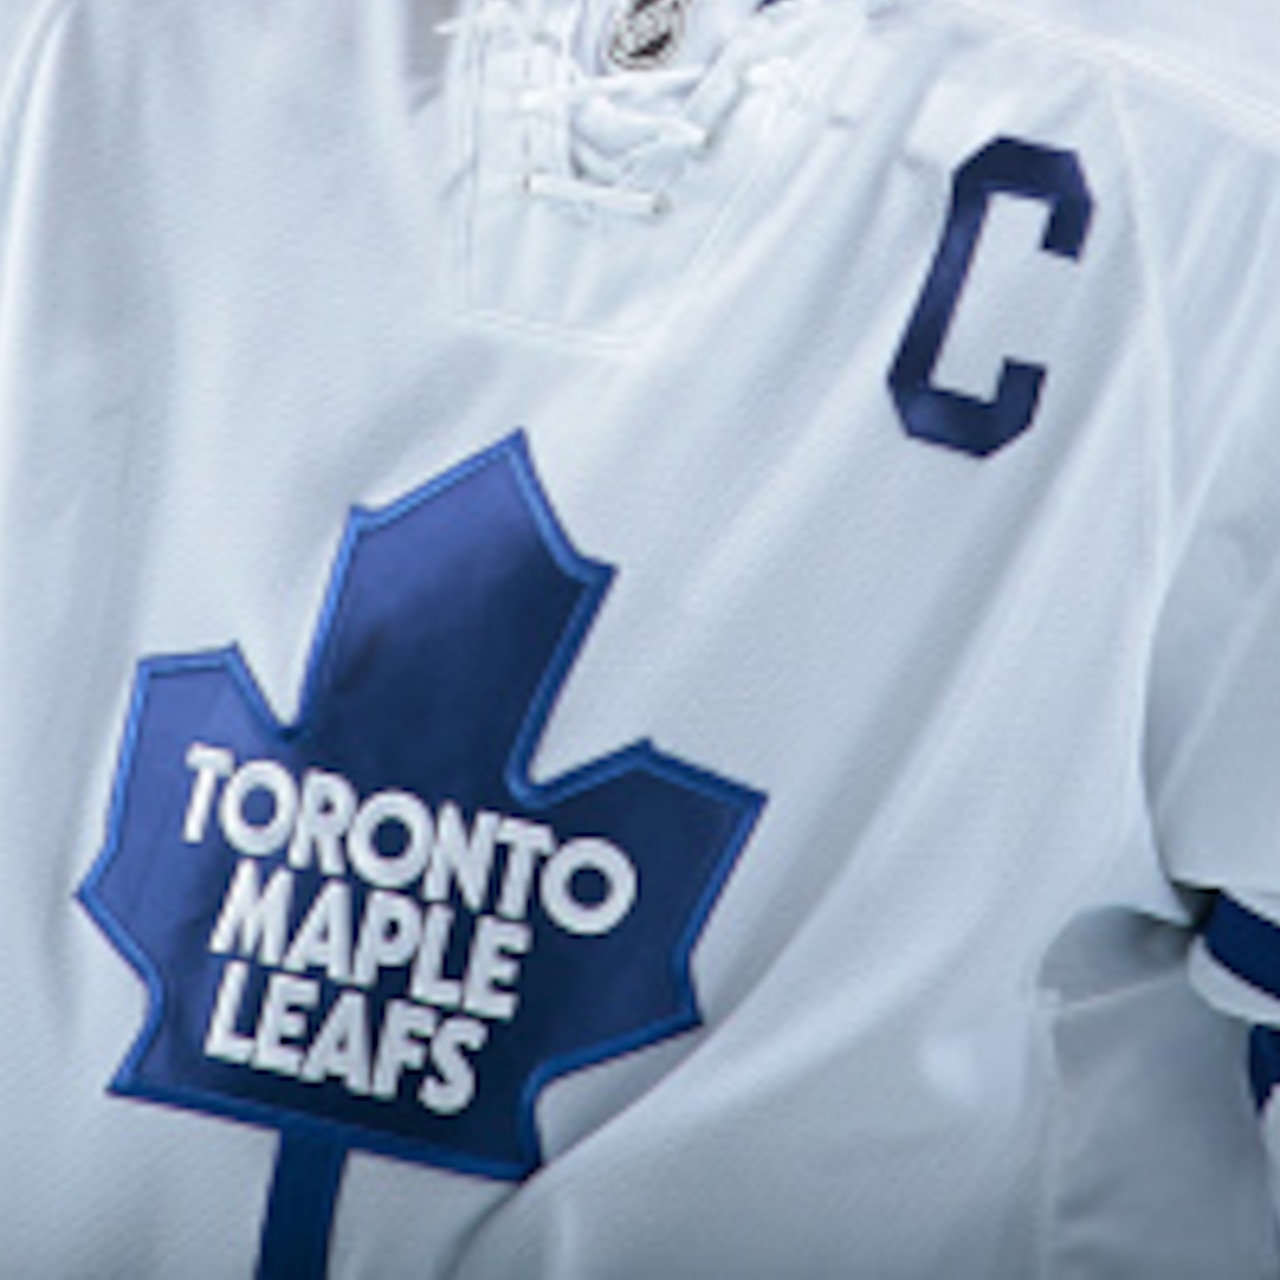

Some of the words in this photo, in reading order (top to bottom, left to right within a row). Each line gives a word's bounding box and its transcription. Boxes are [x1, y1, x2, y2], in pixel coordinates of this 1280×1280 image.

[887, 136, 1094, 458] C
[181, 742, 637, 935] TORONTO
[209, 858, 531, 1020] MAPLE
[204, 960, 489, 1114] LEAFS
